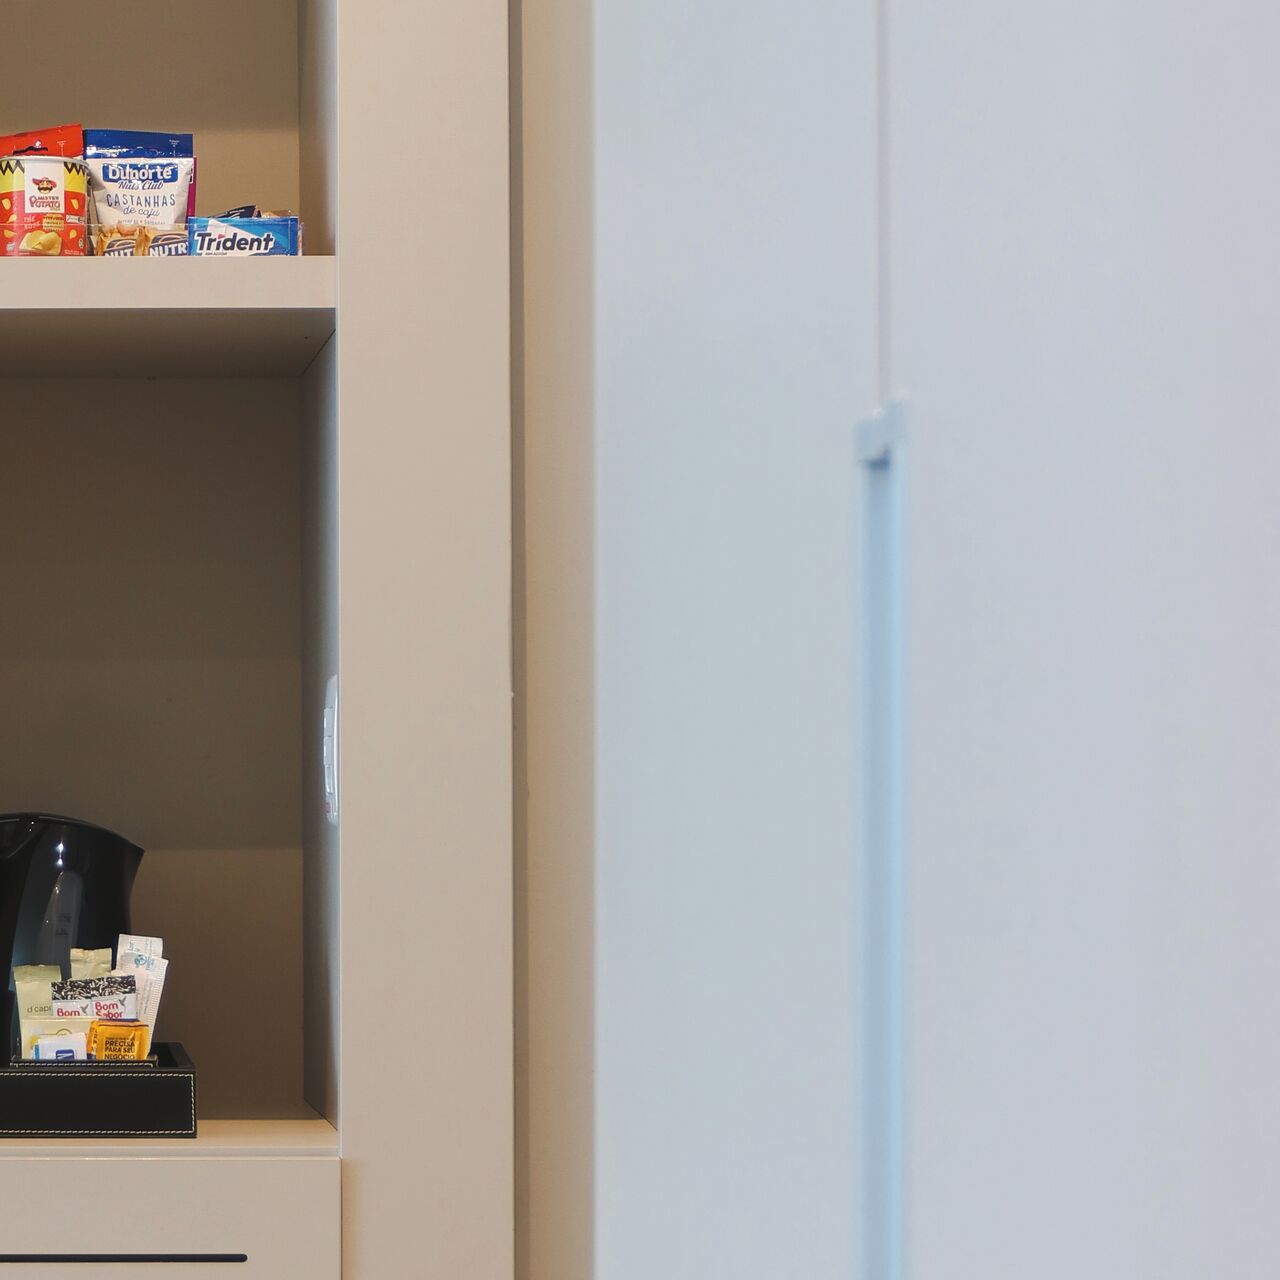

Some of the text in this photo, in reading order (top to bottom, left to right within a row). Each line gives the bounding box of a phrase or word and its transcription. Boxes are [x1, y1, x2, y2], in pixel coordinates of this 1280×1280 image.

[108, 163, 173, 180] Dunorte
[141, 181, 164, 191] Club
[29, 195, 61, 208] POTATO
[106, 193, 176, 207] CASTANHAS
[123, 207, 137, 215] de
[195, 232, 275, 252] Trident
[57, 1007, 81, 1016] Bom
[95, 1002, 119, 1010] Bom
